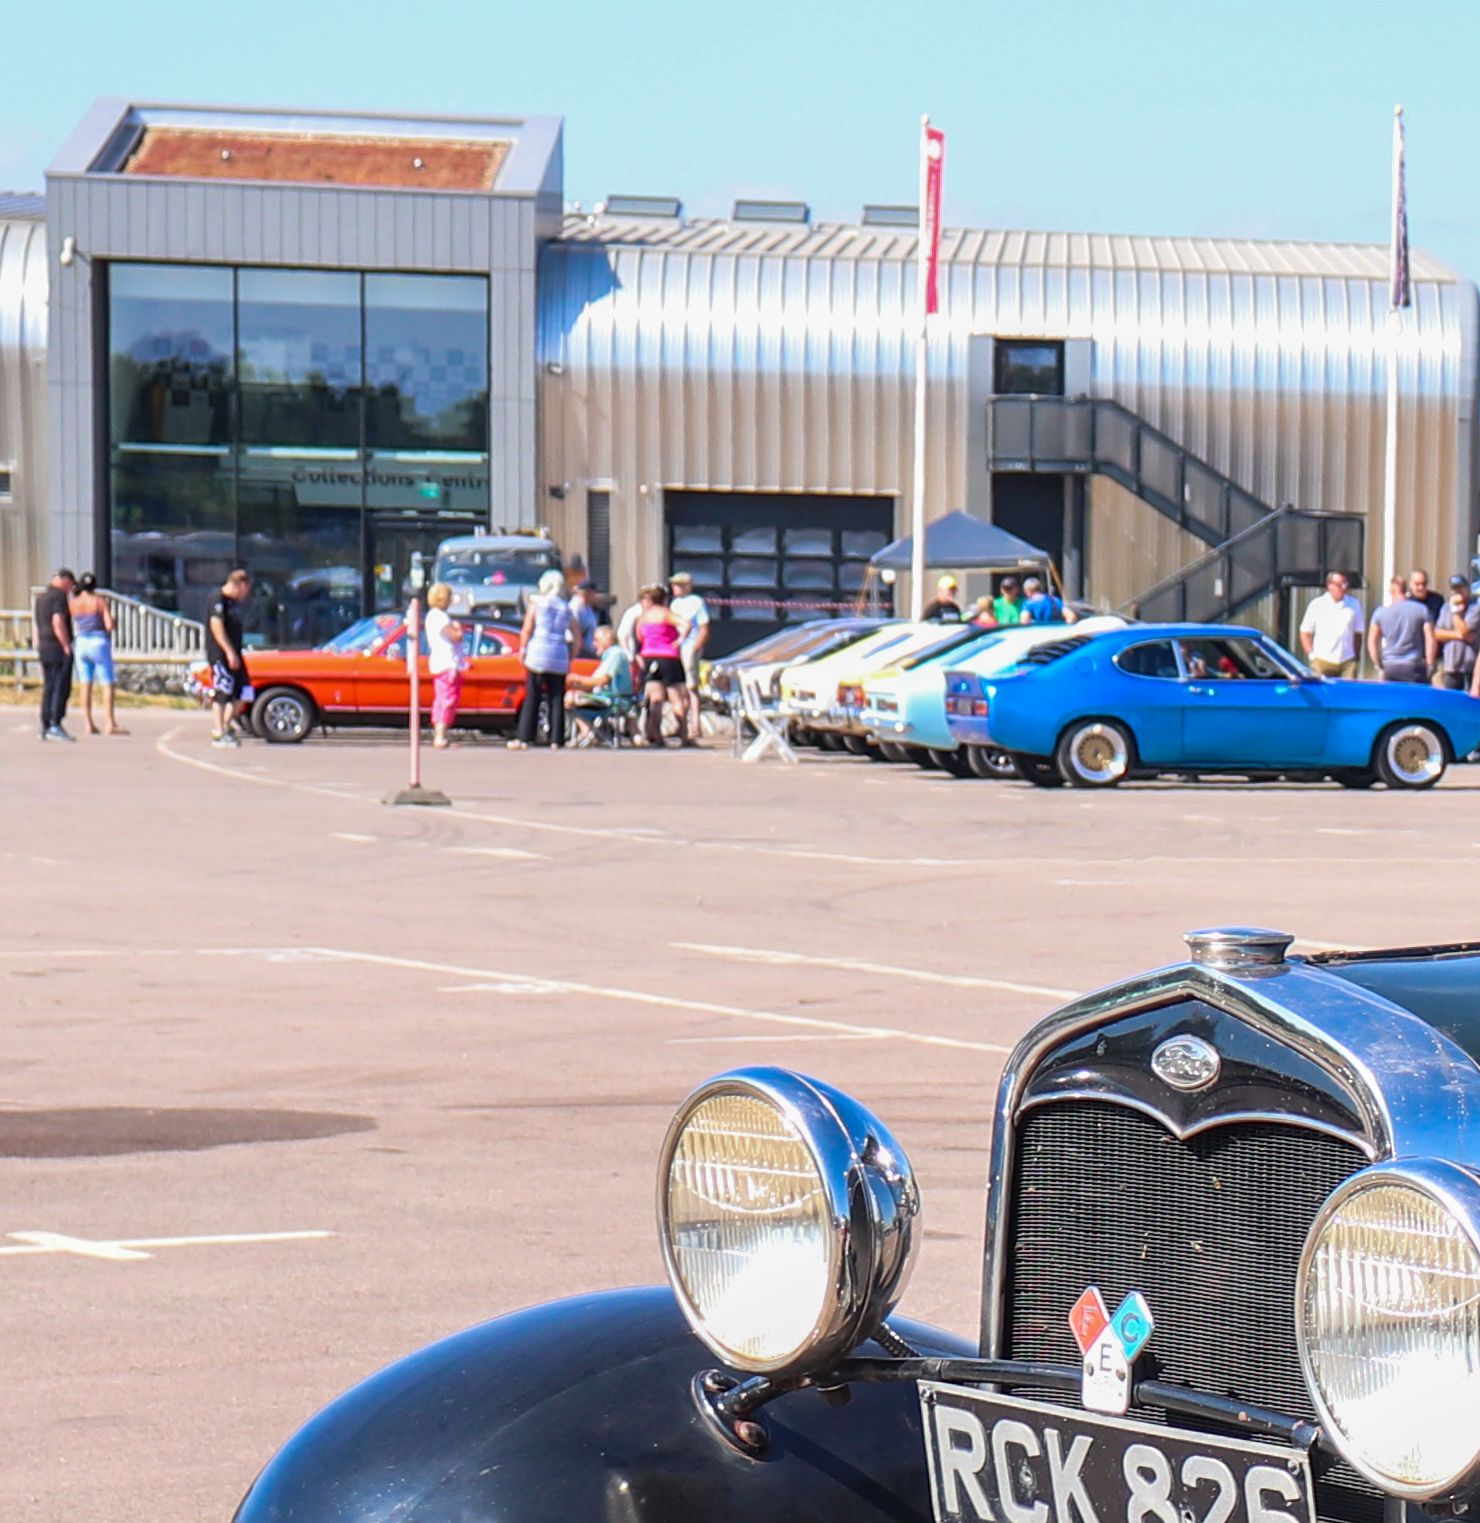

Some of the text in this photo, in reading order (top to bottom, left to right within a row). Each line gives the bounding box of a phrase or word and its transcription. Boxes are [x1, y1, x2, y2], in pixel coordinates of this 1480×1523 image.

[425, 466, 487, 488] Centr
[1121, 1312, 1140, 1343] C
[1100, 1343, 1112, 1372] E
